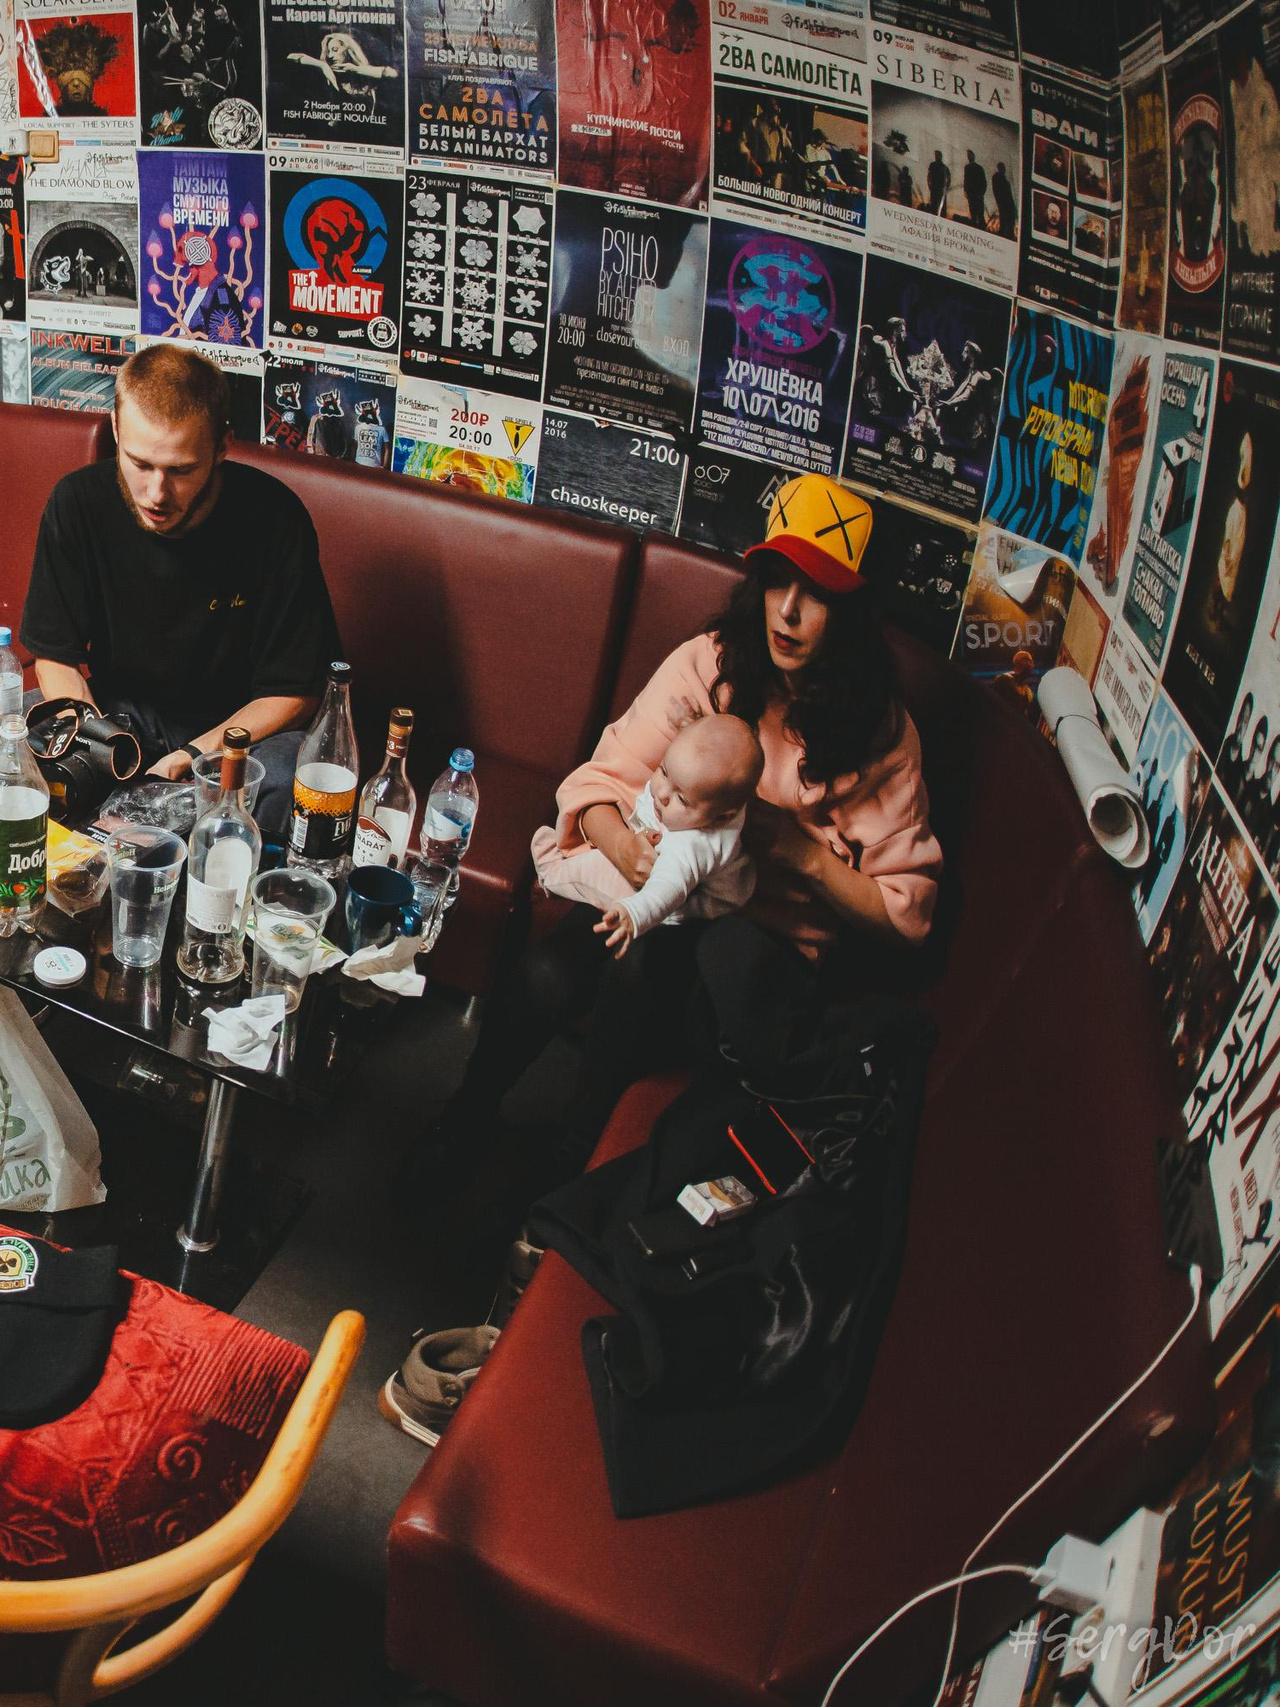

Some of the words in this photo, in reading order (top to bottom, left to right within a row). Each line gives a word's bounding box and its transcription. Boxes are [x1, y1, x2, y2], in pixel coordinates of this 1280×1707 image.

[286, 8, 327, 23] Карен
[328, 10, 396, 25] Арутюнян
[740, 11, 769, 25] ЯНВАРЯ
[873, 29, 893, 44] 09
[424, 48, 538, 71] FISHFABRIQUE
[719, 43, 756, 73] 2ВА
[761, 52, 862, 97] САМОЛЁТА
[876, 54, 1005, 110] SIBERIA
[304, 100, 309, 108] 2
[311, 102, 340, 112] Ноября
[461, 86, 504, 106] 2ВА
[81, 120, 99, 129] THE
[100, 120, 134, 129] SYTERS
[283, 110, 301, 119] FISH
[302, 111, 342, 121] FABRIQUE
[344, 113, 387, 125] NOUVELLE
[419, 103, 549, 132] САМОЛЕТА
[419, 123, 476, 142] БЕЛЫЙ
[481, 128, 548, 149] БАРХАТ
[1031, 109, 1099, 149] ВРАГИ
[269, 156, 286, 167] 09
[419, 138, 449, 151] DAS
[453, 141, 548, 164] ANIMATORS
[29, 178, 48, 188] THE
[49, 178, 101, 189] DIAMOND
[103, 179, 135, 190] BLOW
[172, 176, 229, 195] МУЗЫКА
[408, 175, 427, 190] 23
[427, 179, 461, 189] ФЕВРАЛЯ
[172, 193, 229, 211] СМУТНОГО
[717, 174, 761, 198] БОЛЬШОЙ
[763, 184, 822, 214] НОВОГОДНИЙ
[823, 201, 862, 224] КОНЦЕРТ
[172, 208, 229, 227] ВРЕМЕНИ
[883, 207, 944, 234] WEDNESDAY
[946, 226, 994, 250] MORNING
[901, 226, 941, 244] АФАЗИЯ
[944, 237, 976, 256] БРОКА
[600, 227, 659, 281] PSIHO
[292, 272, 309, 286] THE
[599, 269, 613, 295] BY
[293, 284, 382, 315] MOVEMENT
[32, 329, 135, 357] INKWELL
[557, 327, 585, 348] 20:00
[32, 356, 70, 370] ALBUM
[724, 356, 823, 407] ХРУЩЁВКА
[32, 396, 80, 410] TOUCH
[544, 427, 568, 439] 2016
[545, 417, 568, 429] 14.07
[448, 425, 493, 446] 20:00
[629, 438, 681, 466] 21:00
[550, 486, 658, 526] chaoskeeper
[1, 1238, 28, 1252] MALT
[1216, 1469, 1254, 1611] MUST
